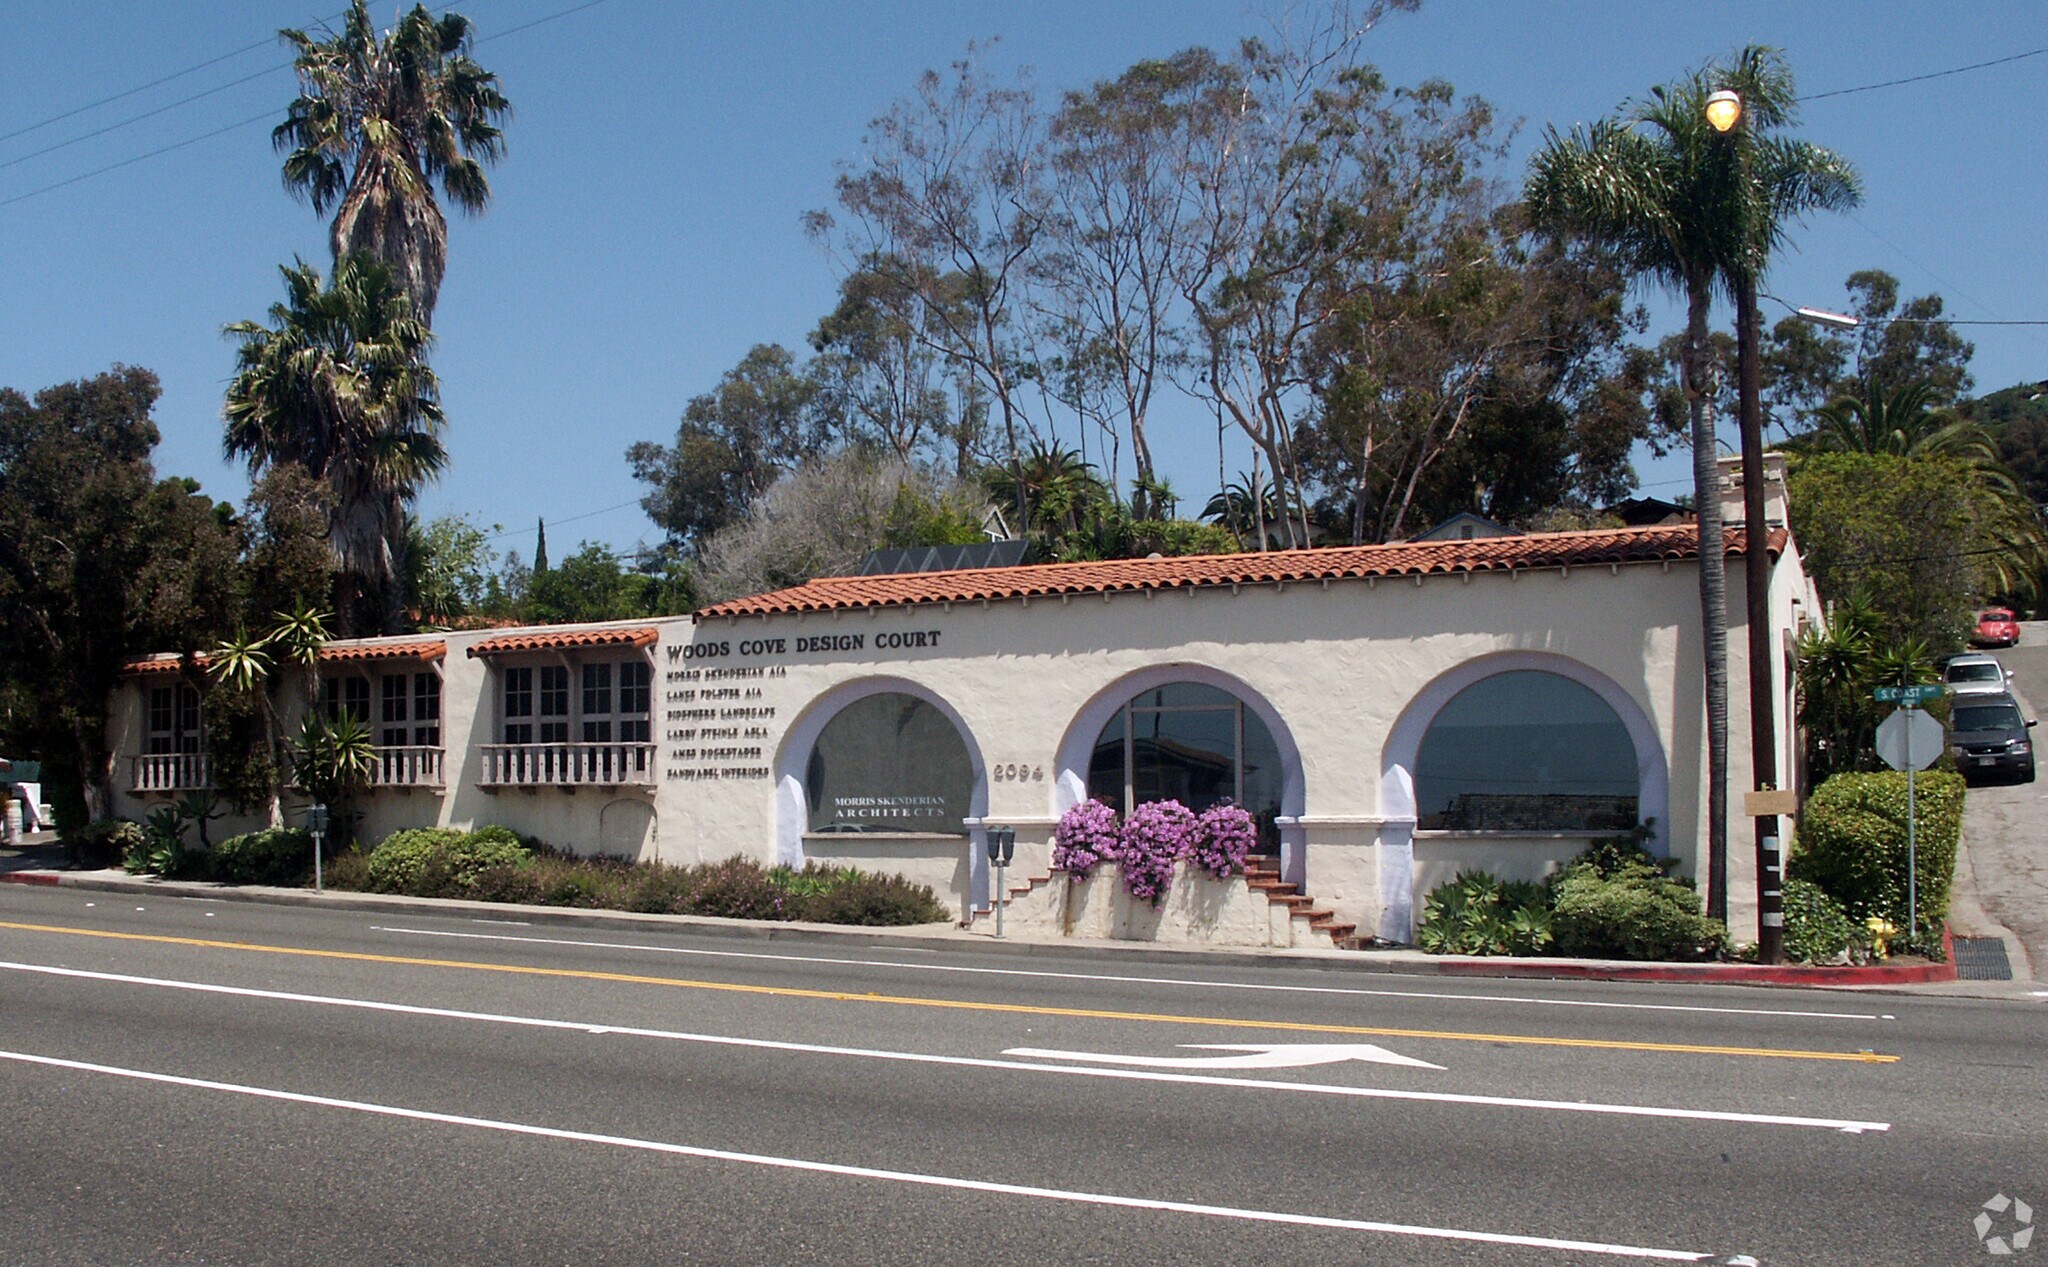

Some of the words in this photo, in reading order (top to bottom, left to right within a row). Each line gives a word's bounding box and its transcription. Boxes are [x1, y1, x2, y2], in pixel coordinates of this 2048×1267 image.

[667, 641, 730, 661] WOODS
[740, 639, 786, 656] COVE
[796, 634, 865, 653] DESIGN
[875, 631, 941, 648] COURT
[667, 670, 700, 680] MORRIS
[705, 667, 764, 679] SKENDERIAN
[770, 666, 786, 678] AIA
[745, 688, 762, 699] AIA
[1891, 687, 1920, 699] COAST
[667, 709, 716, 720] BIOSPHERE
[720, 707, 775, 719] LANDSCAPE
[667, 729, 696, 740] LARRY
[721, 767, 769, 779] INTERIORS
[835, 798, 875, 806] MORRIS
[877, 796, 945, 805] SKENDERIAN
[835, 808, 945, 817] ARCHITECTS
